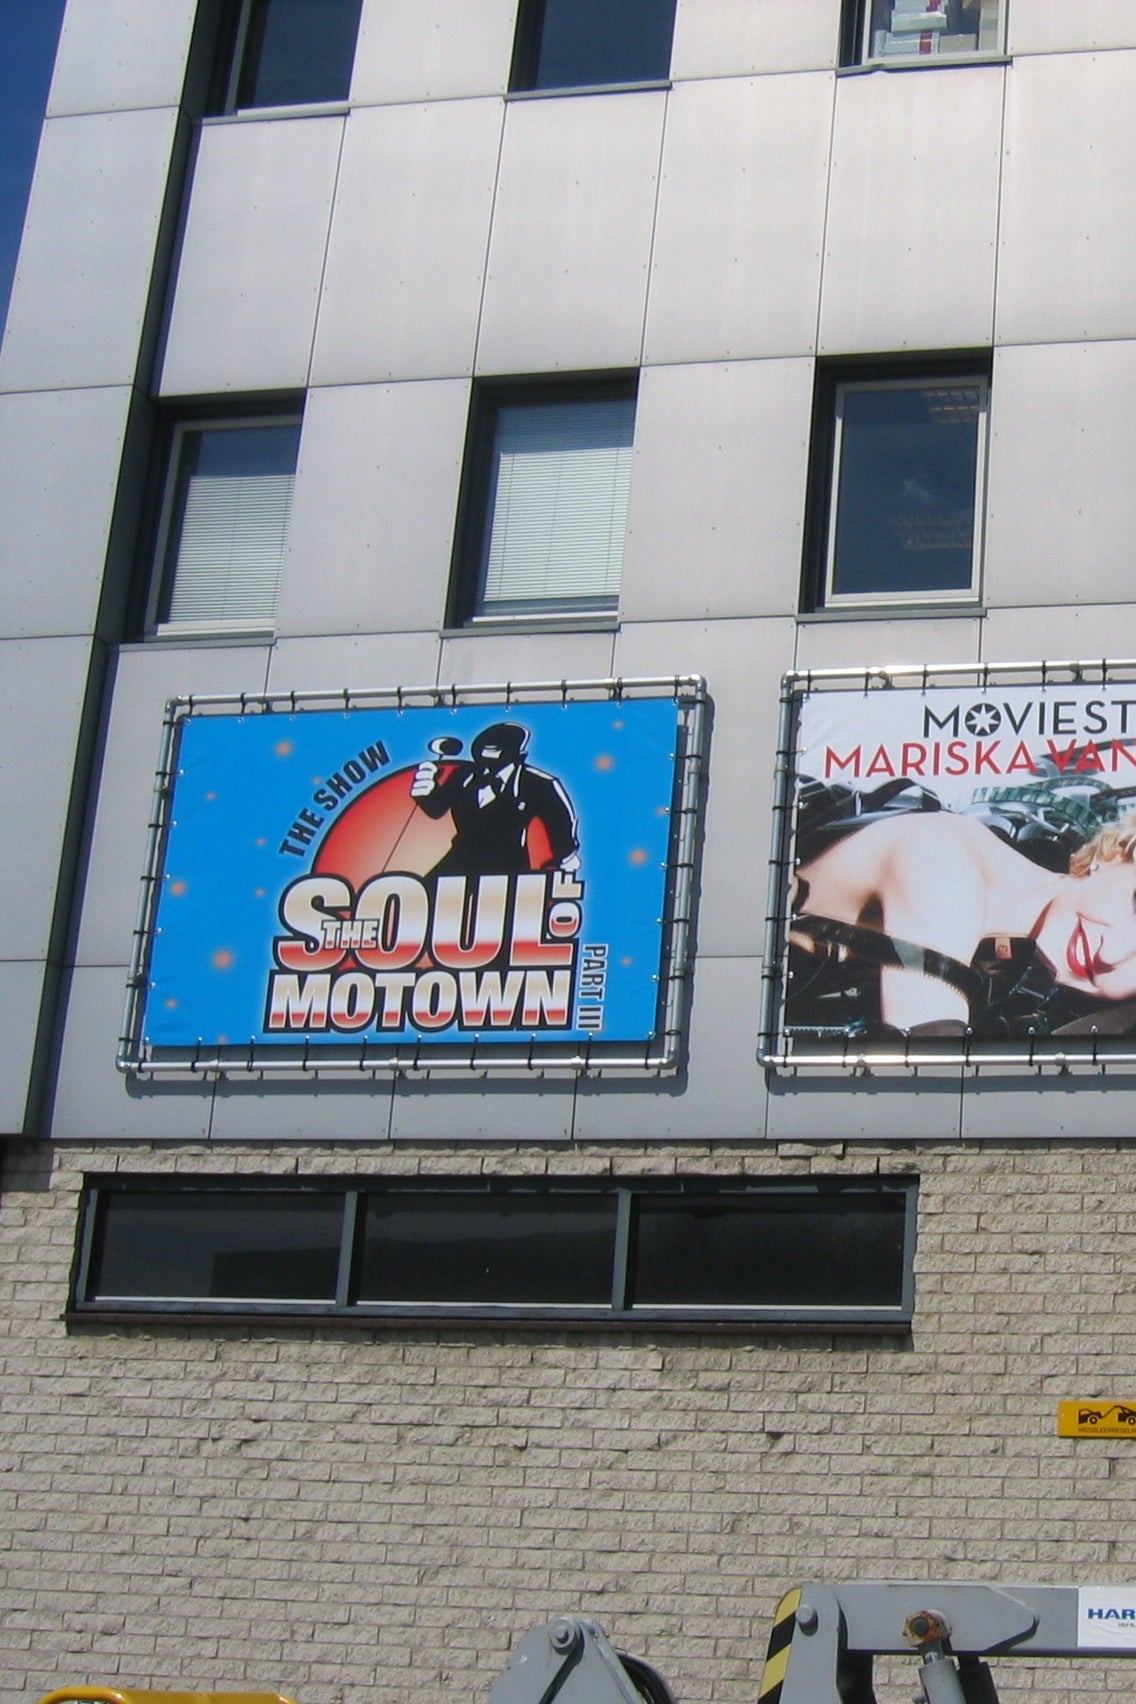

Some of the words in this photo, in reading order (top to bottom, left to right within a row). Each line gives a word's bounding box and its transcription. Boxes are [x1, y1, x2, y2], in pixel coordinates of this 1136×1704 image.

[824, 740, 1038, 779] MARISKA
[279, 807, 325, 857] THE
[313, 739, 391, 811] SHOW
[276, 873, 573, 971] SOUL
[549, 871, 582, 938] OF
[322, 920, 378, 950] THE
[268, 970, 571, 1029] MOTOWN
[578, 942, 608, 1000] PART
[577, 1004, 604, 1031] III
